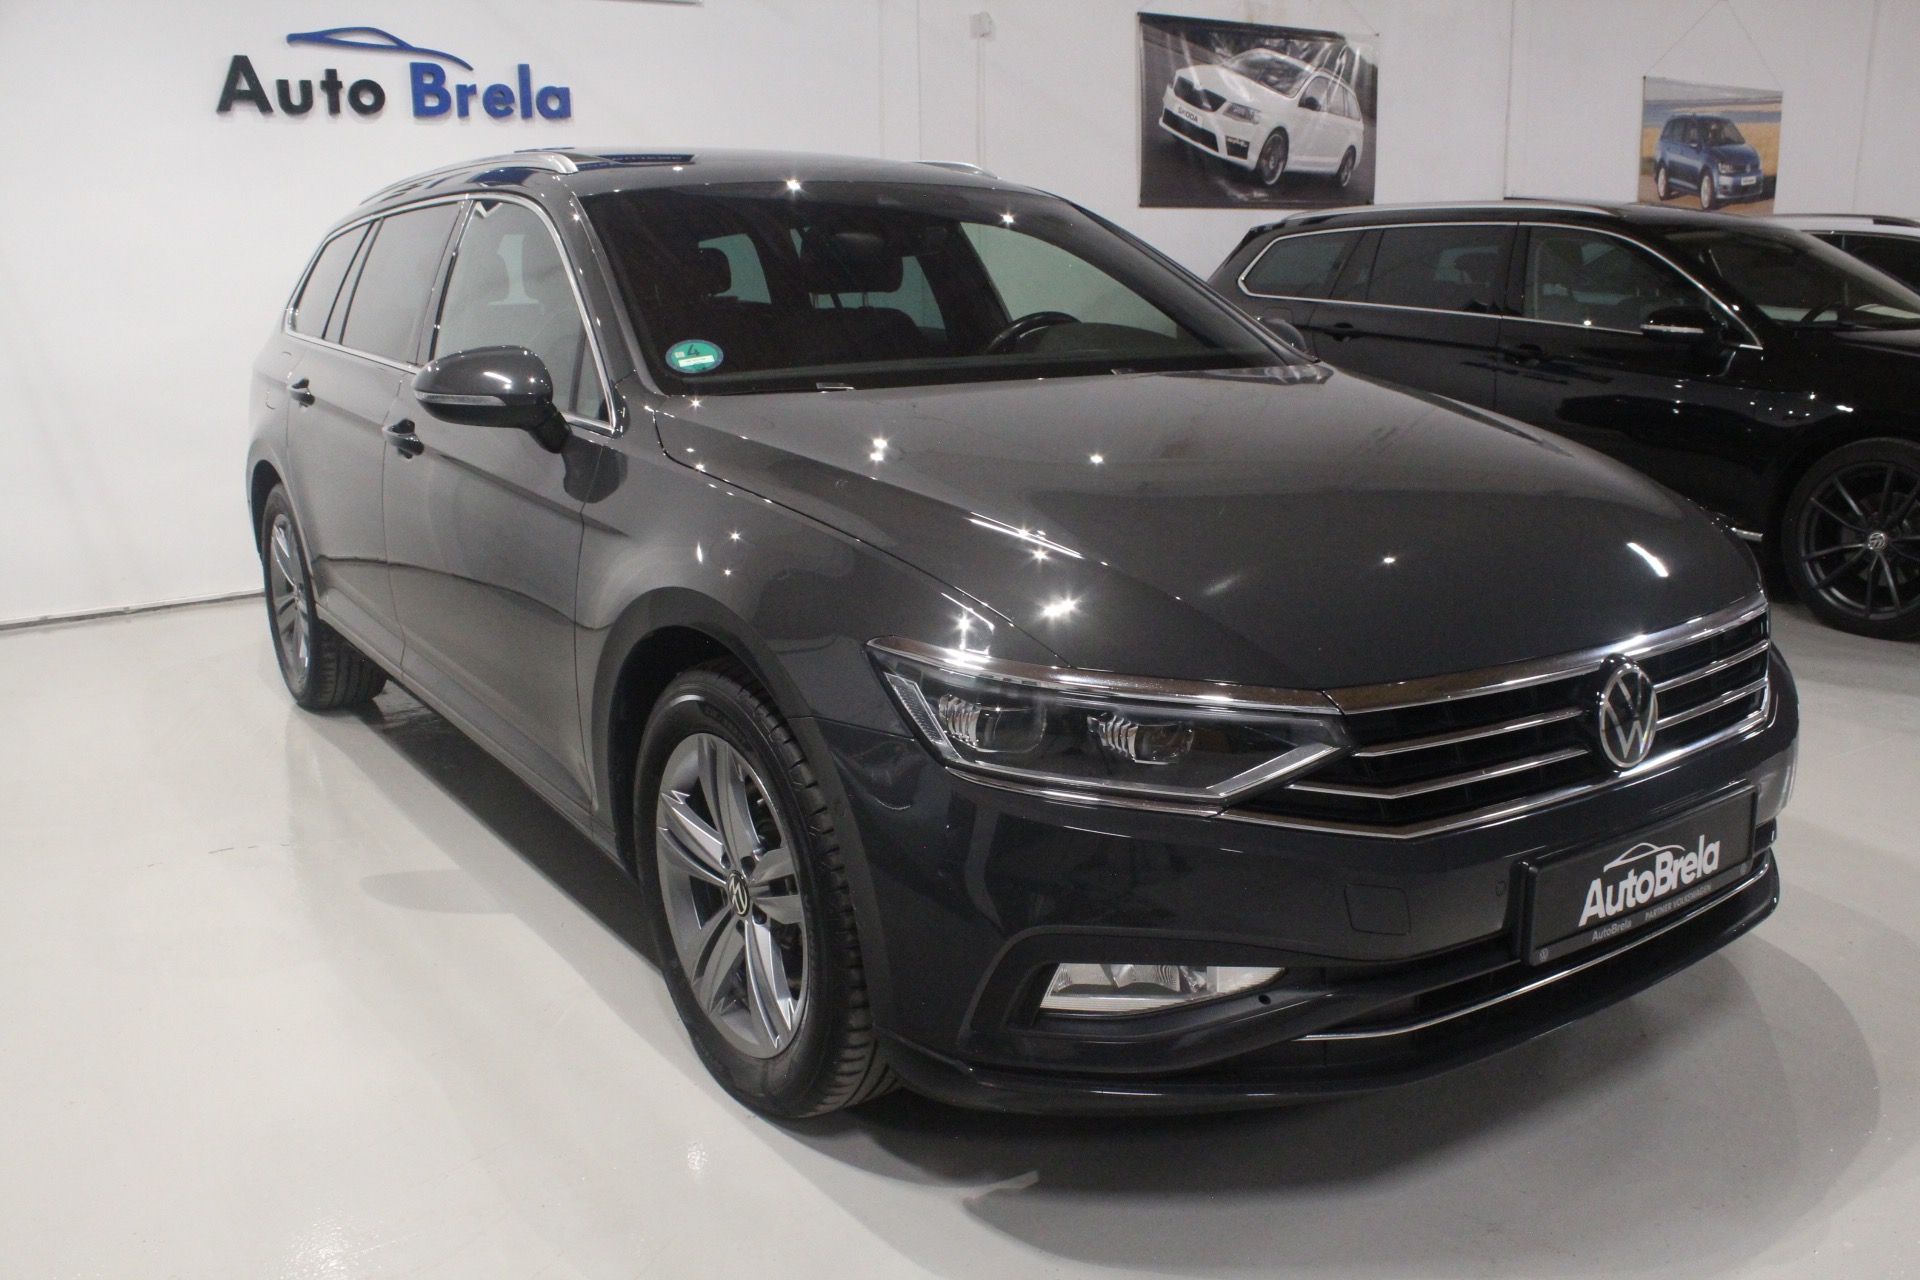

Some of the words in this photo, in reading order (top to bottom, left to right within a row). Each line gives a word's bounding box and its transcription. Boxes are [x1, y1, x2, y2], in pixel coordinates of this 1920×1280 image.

[216, 54, 386, 117] Auto
[409, 61, 572, 120] Brela
[687, 344, 700, 355] 4
[1578, 834, 1720, 927] AutoBrela
[1591, 919, 1632, 942] AutoBrela
